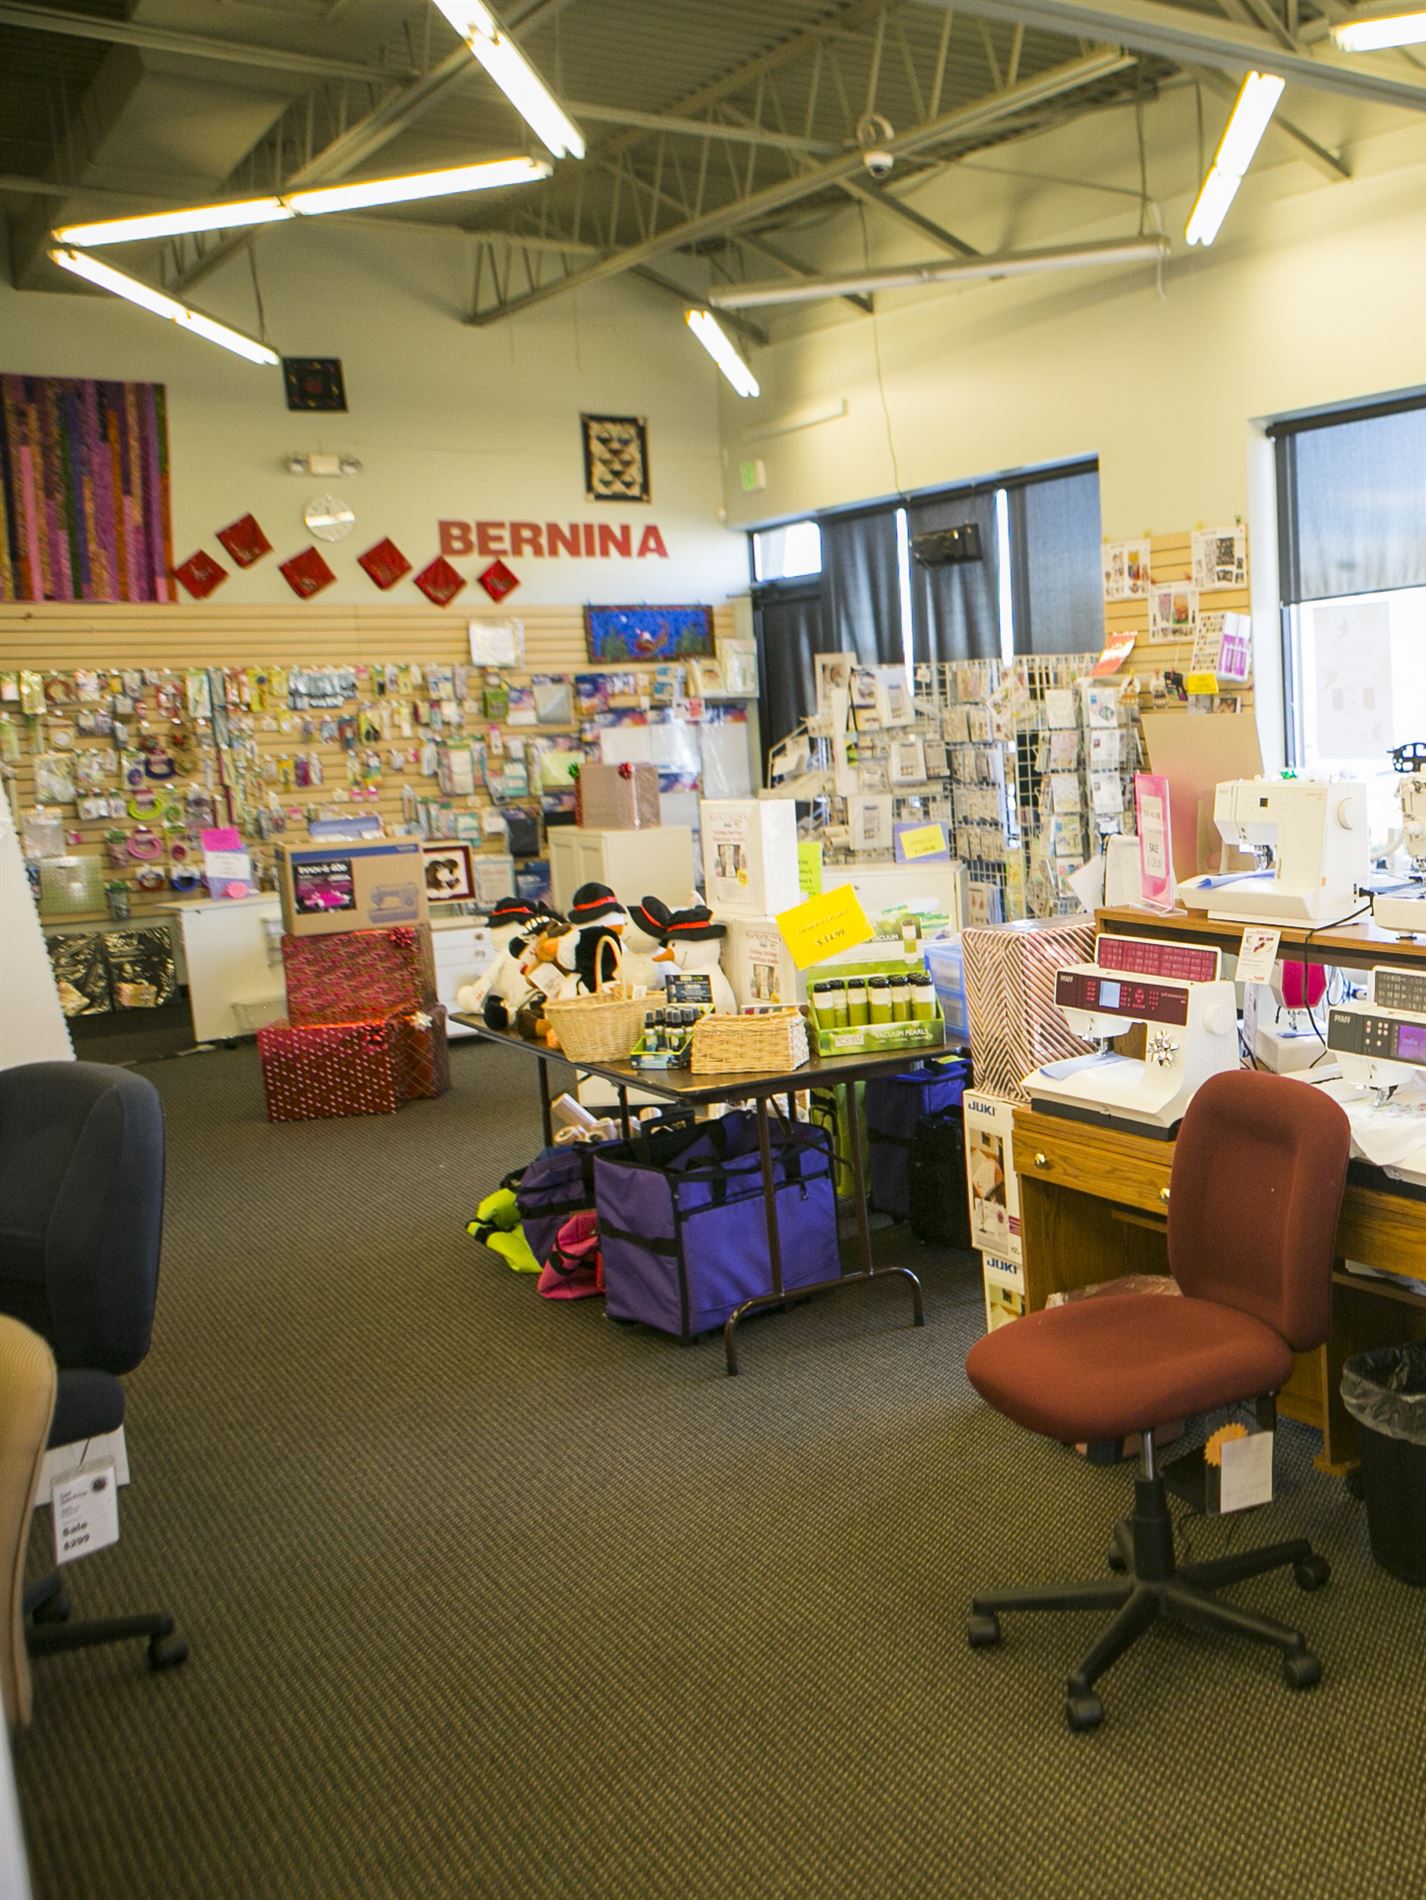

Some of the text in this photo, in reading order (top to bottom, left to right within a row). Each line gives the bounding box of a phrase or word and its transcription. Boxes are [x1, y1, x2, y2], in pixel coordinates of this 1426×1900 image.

[438, 519, 670, 559] BERNINA
[1334, 1014, 1351, 1024] PFAFF
[968, 1101, 996, 1117] JUKI
[987, 1258, 1018, 1275] JUKI
[62, 1521, 88, 1536] Sale
